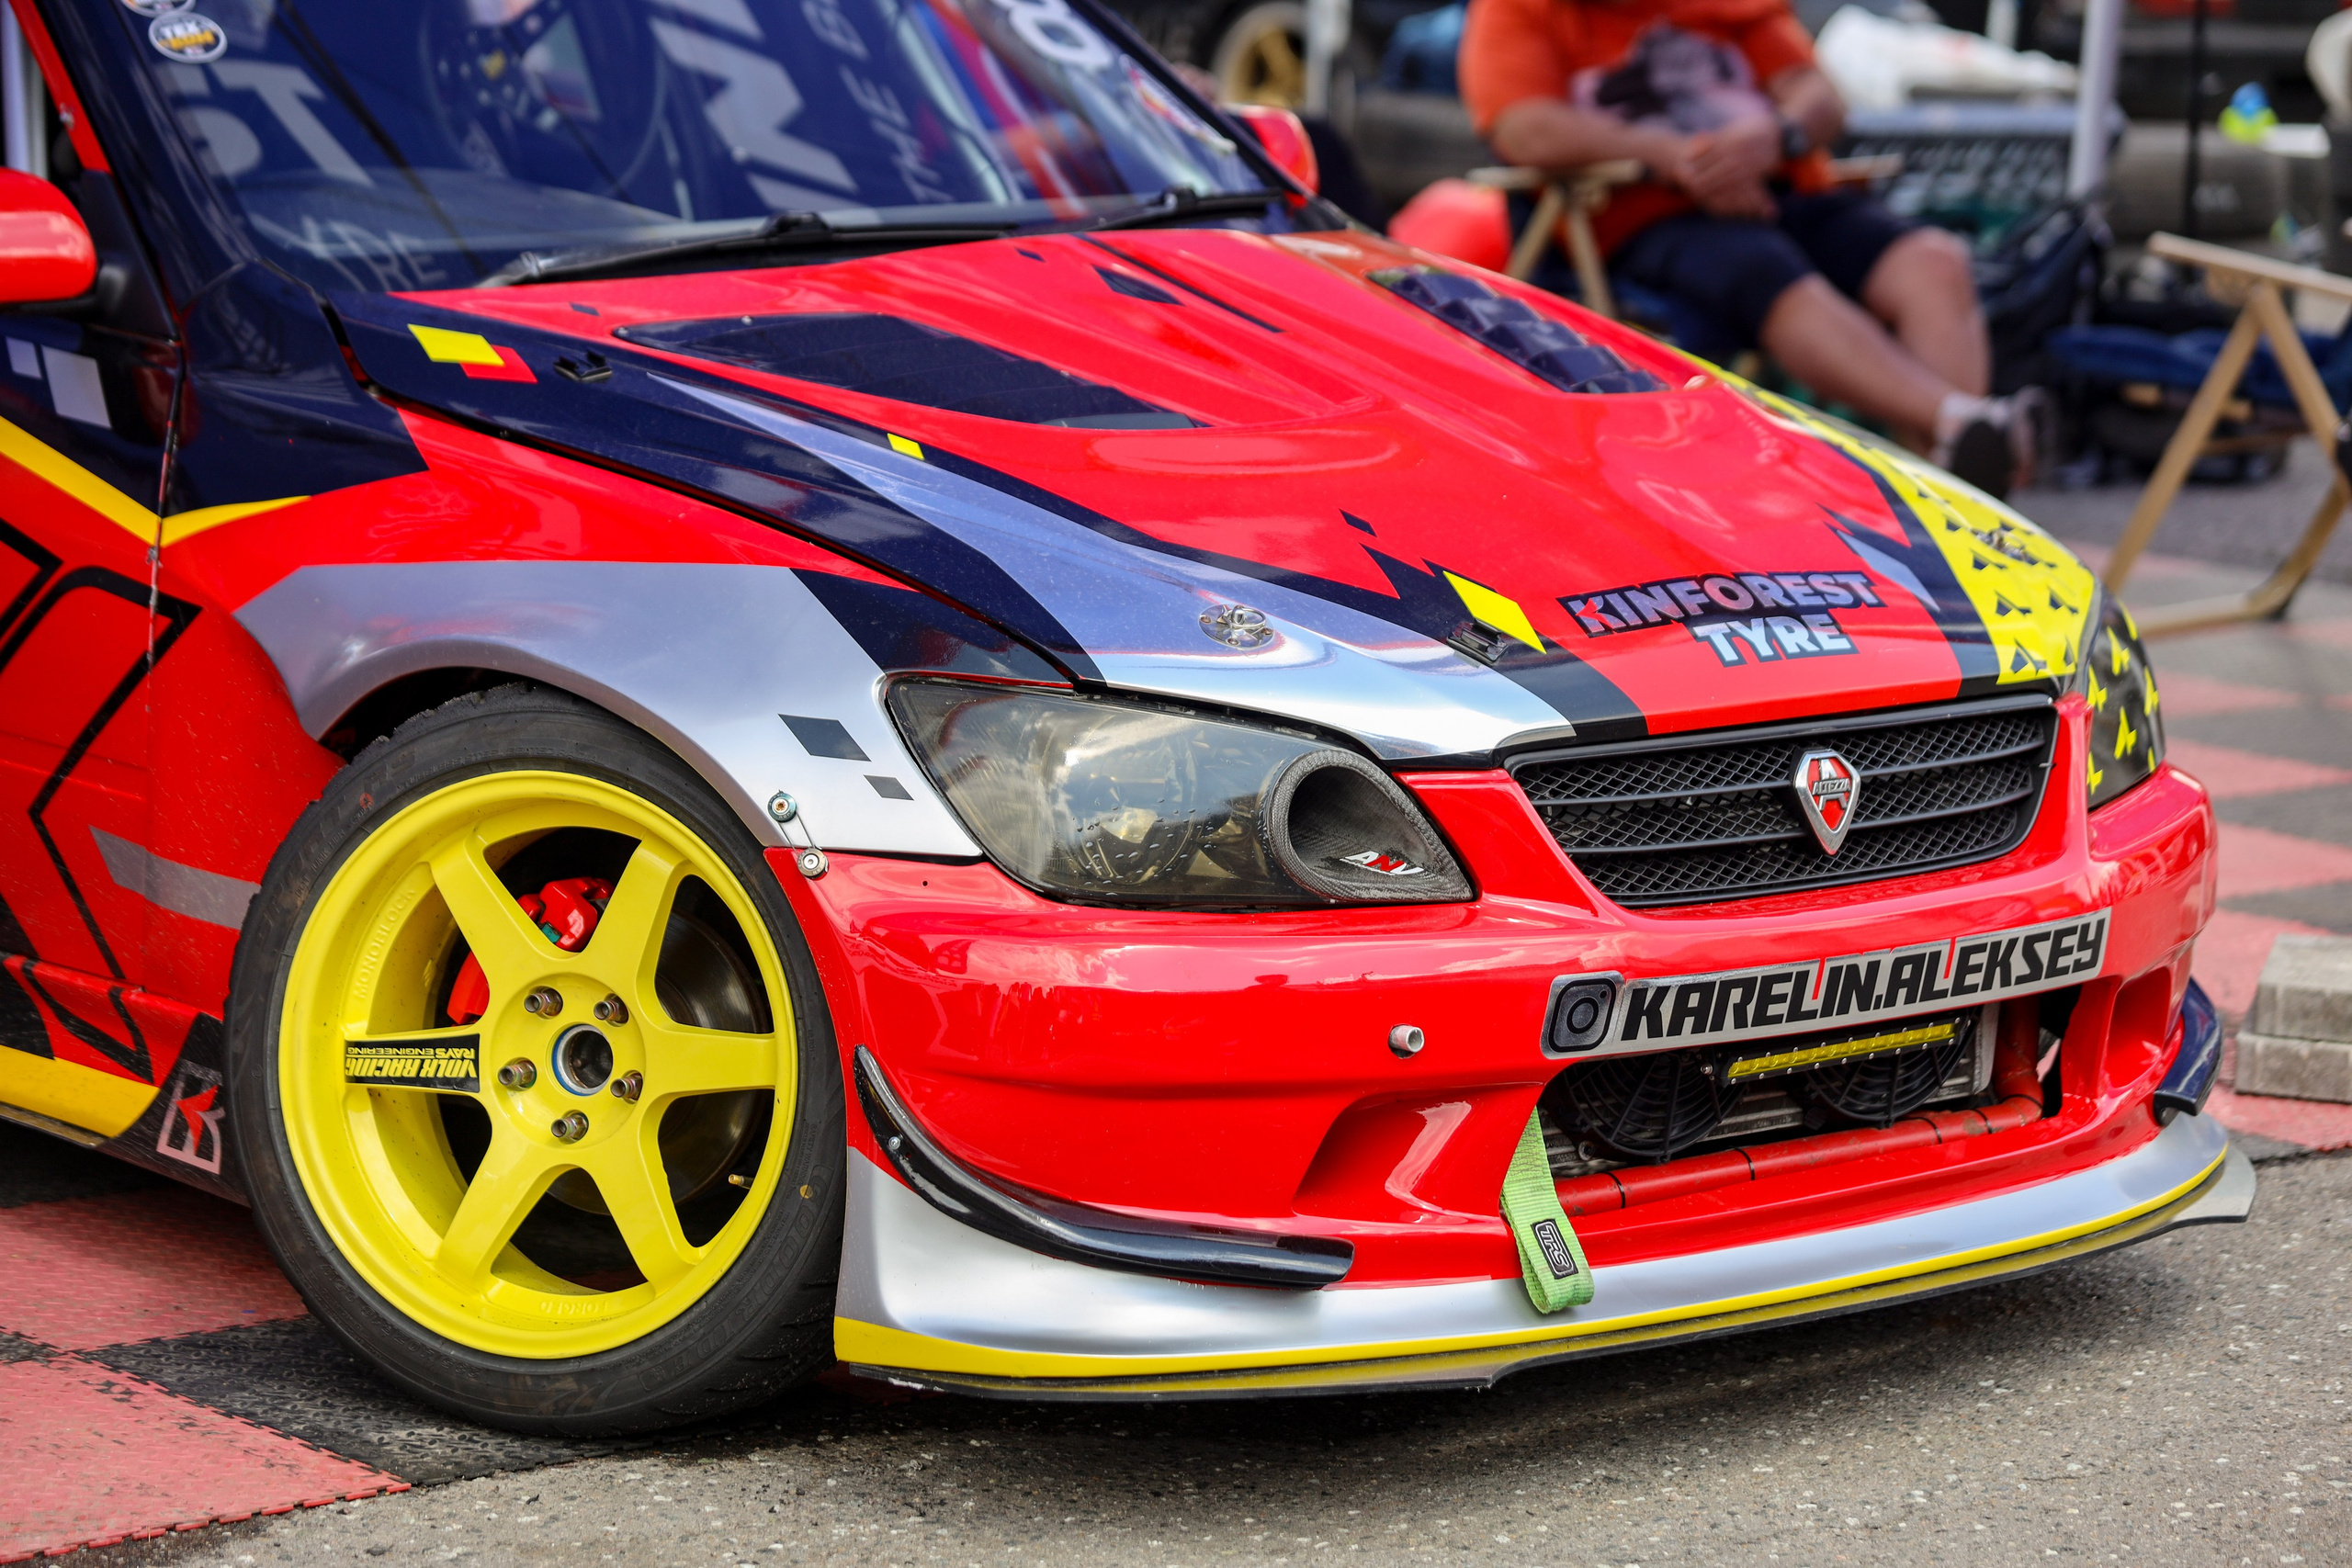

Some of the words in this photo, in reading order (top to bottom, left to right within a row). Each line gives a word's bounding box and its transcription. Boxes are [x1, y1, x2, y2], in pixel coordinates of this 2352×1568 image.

[1566, 571, 1881, 634] KINFOREST
[1693, 614, 1852, 662] TYRE
[1812, 777, 1851, 795] ALTEZZA
[353, 889, 415, 999] MONOBLOCK
[1621, 917, 2107, 1042] KARELIN.ALEKSEY
[345, 1058, 422, 1077] RACING
[347, 1047, 435, 1055] ENGINEERING
[419, 1059, 478, 1078] VOLK
[435, 1048, 475, 1059] RAYS
[1539, 1224, 1570, 1271] TRS
[668, 1174, 829, 1378] GOODRIDE
